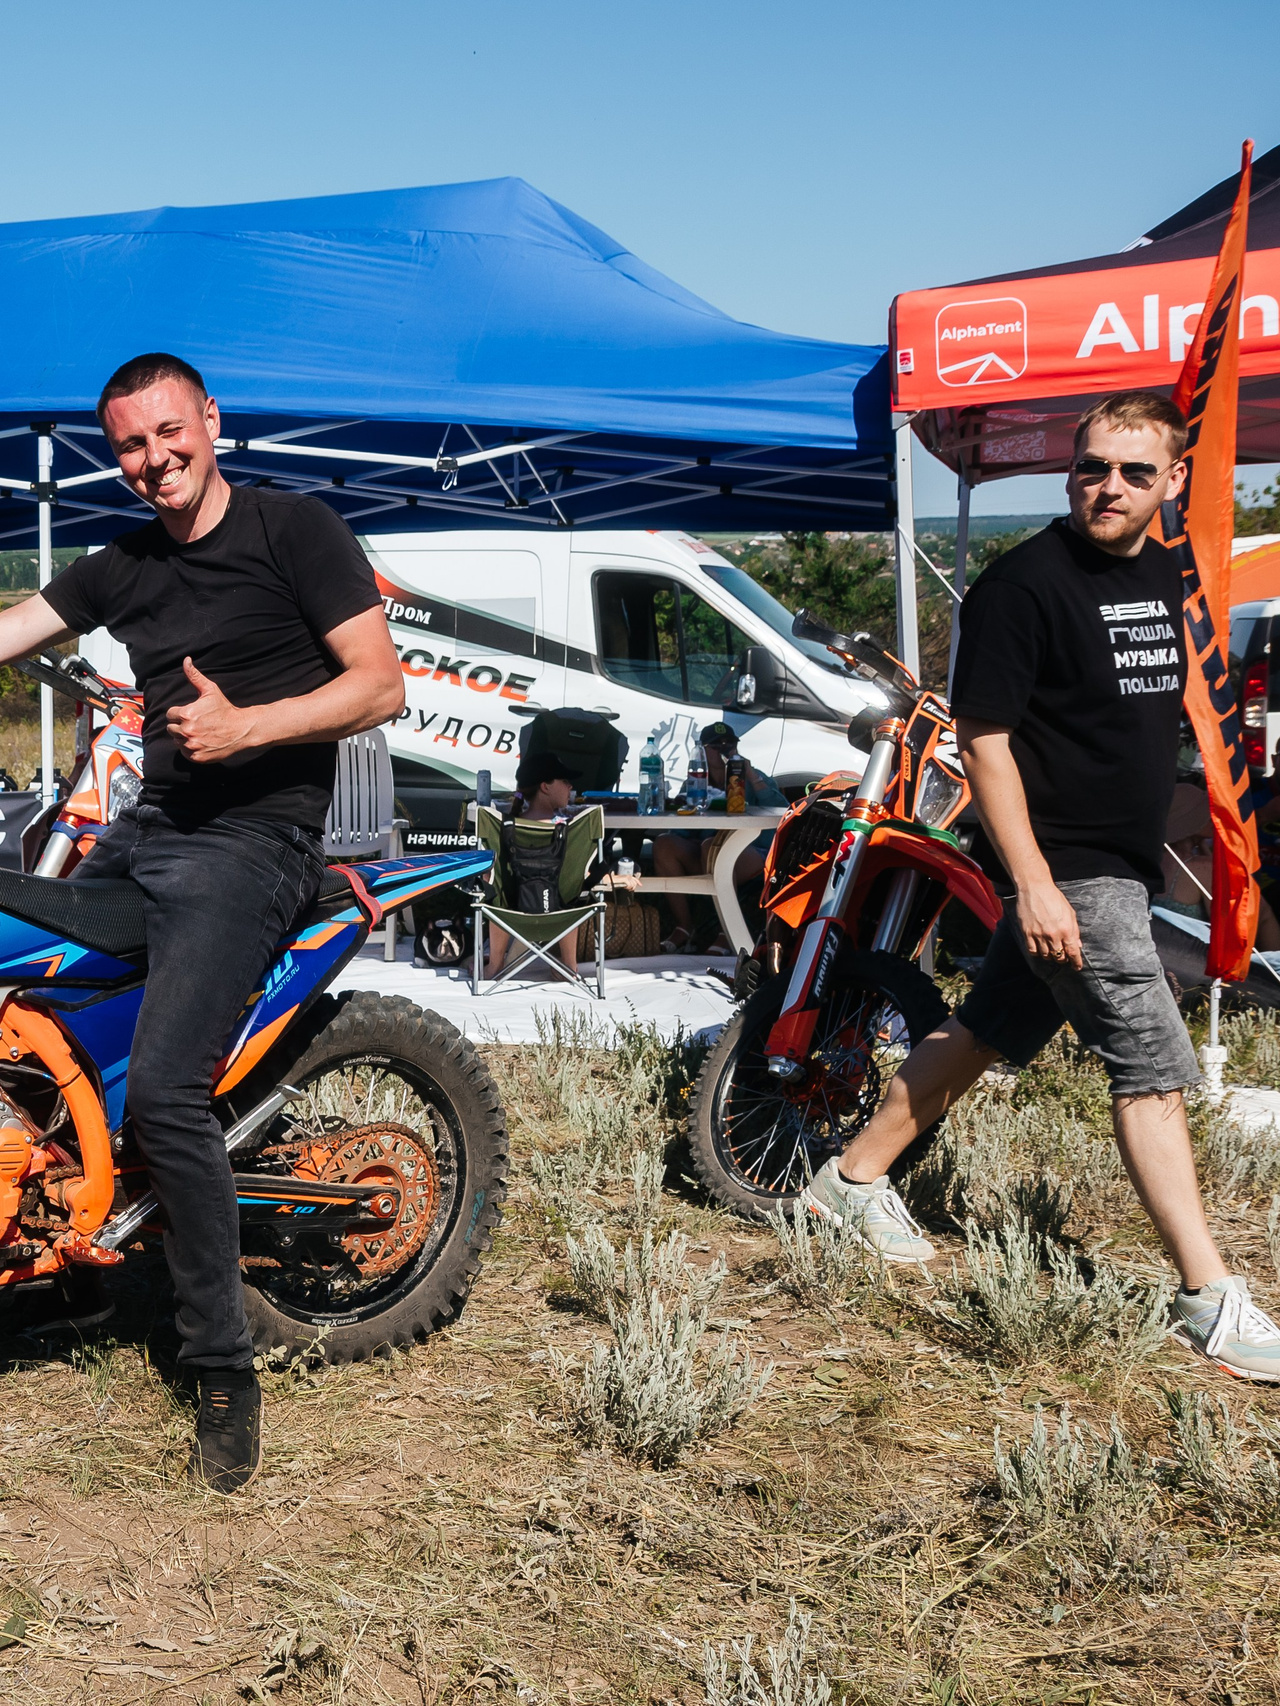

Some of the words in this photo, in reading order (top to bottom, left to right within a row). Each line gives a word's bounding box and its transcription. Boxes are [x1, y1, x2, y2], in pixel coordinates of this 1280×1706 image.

[940, 320, 1023, 342] AlphaTent
[1108, 623, 1176, 644] ПОШЛА
[1113, 647, 1179, 669] МУЗЫКА
[394, 644, 537, 703] СКОЕ
[1118, 674, 1179, 695] ПОШЛА
[266, 964, 300, 1003] FXMOTO.RU
[275, 1205, 317, 1214] K10
